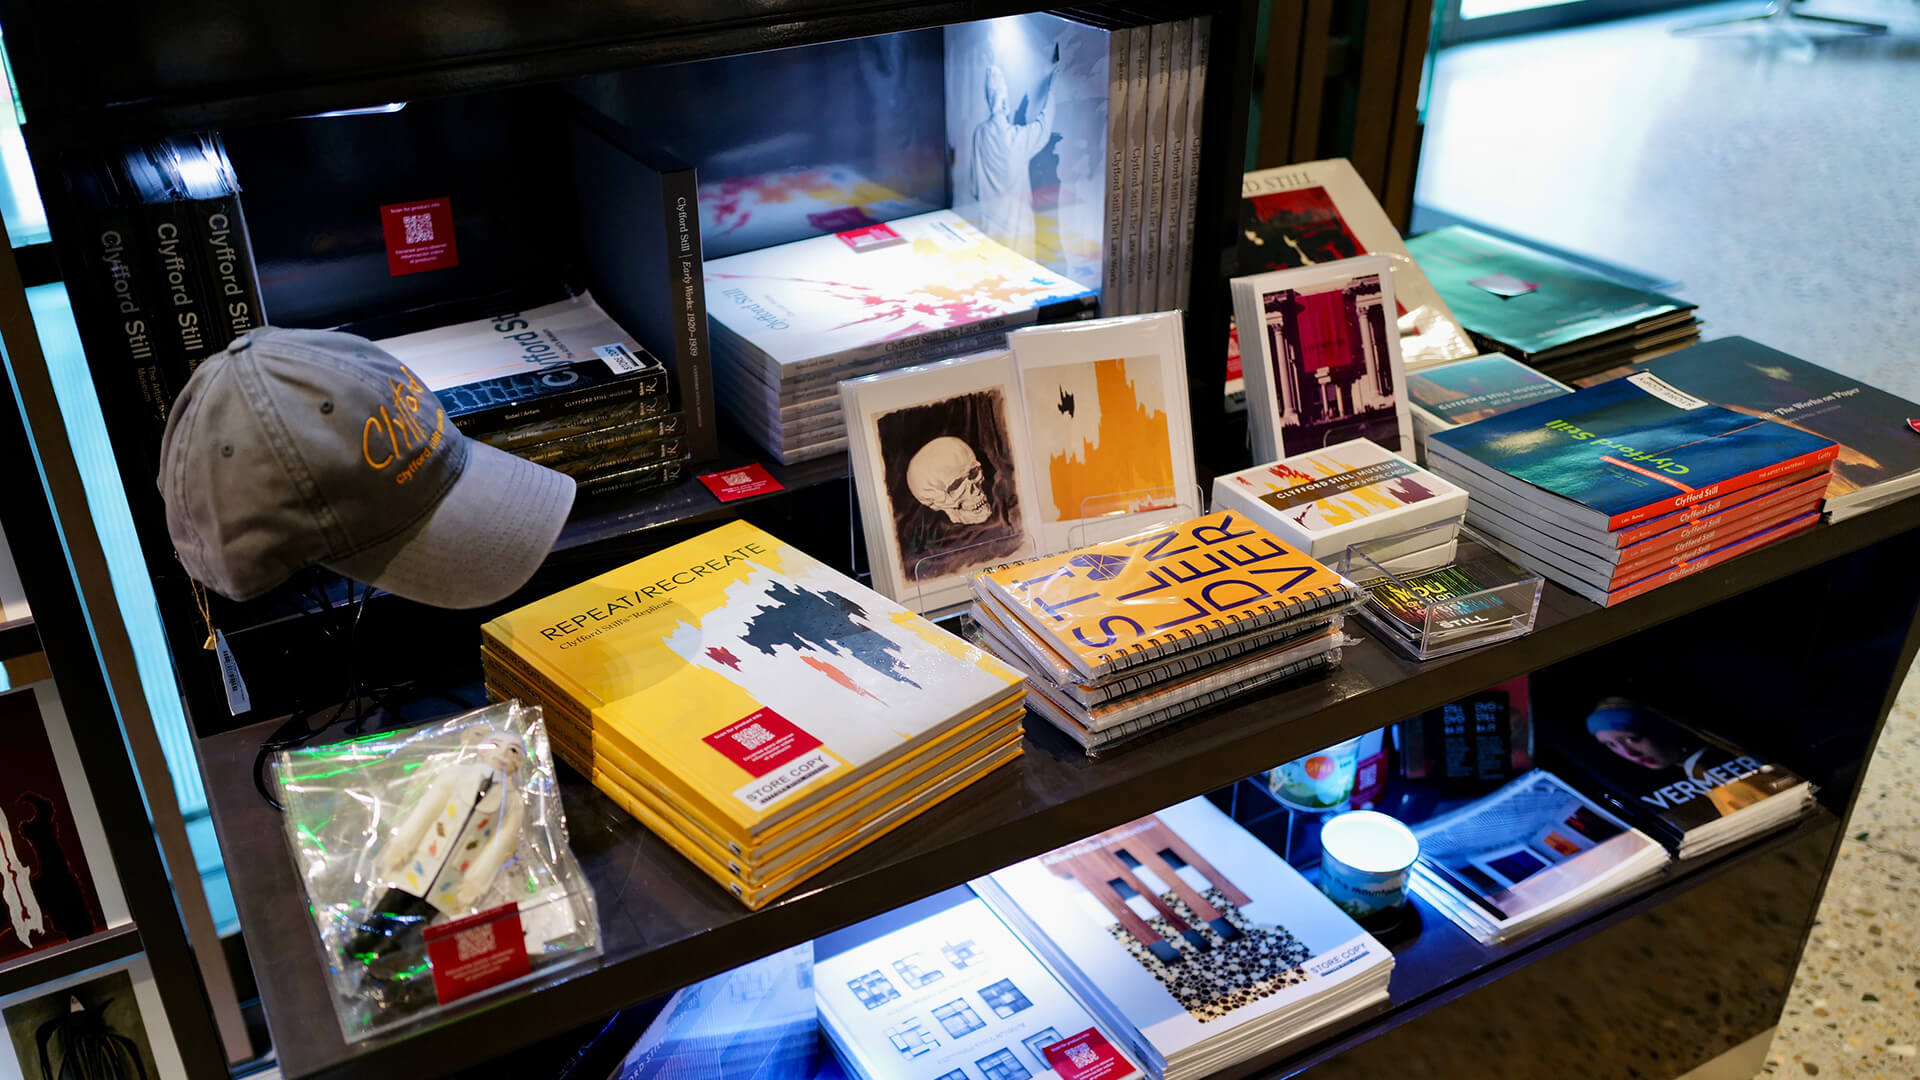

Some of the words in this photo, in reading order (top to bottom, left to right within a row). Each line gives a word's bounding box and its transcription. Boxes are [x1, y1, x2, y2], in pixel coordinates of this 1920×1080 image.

[1112, 151, 1121, 191] Clyfford
[1130, 148, 1140, 187] Clyfford
[676, 196, 688, 232] Clyfford
[1112, 217, 1120, 234] The
[680, 234, 690, 252] Still
[157, 223, 193, 306] Clyfford
[178, 312, 204, 350] Still
[208, 213, 244, 296] Clyfford
[228, 302, 252, 335] Stil
[682, 262, 693, 284] Early
[101, 231, 140, 314] Clyfford
[124, 320, 152, 359] Still
[722, 288, 751, 304] Still
[741, 303, 790, 330] Clyfford
[885, 335, 920, 352] Clyfford
[942, 327, 958, 340] The
[960, 324, 978, 337] Late
[979, 318, 1004, 332] Works
[503, 331, 580, 388] Clyfford
[564, 397, 593, 408] CLYFFORD
[594, 394, 606, 402] STILL
[1438, 394, 1487, 410] CLYFFORD
[1486, 391, 1511, 401] STILL
[1512, 382, 1555, 394] MUSEUM
[1774, 406, 1796, 416] The
[1792, 398, 1823, 410] Works
[1832, 387, 1860, 398] Paper
[1544, 419, 1597, 441] Still
[1590, 437, 1690, 476] Clyfford
[1276, 480, 1329, 500] CLYFFORD
[1328, 474, 1355, 486] STILL
[1357, 462, 1400, 476] MUSEUM
[1675, 490, 1704, 506] Clyfford
[1704, 486, 1719, 498] Still
[1680, 504, 1707, 522] Clyfford
[1708, 501, 1721, 512] Still
[1675, 535, 1702, 552] Clyfford
[1702, 530, 1716, 542] Still
[1680, 521, 1708, 538] Clyfford
[1708, 516, 1722, 528] Still
[1670, 548, 1696, 564] Clyfford
[1697, 544, 1711, 554] Still
[1668, 564, 1696, 580] Clyfford
[1696, 559, 1710, 570] Still
[540, 542, 767, 640] REPEAT/RECREATE
[559, 629, 603, 650] Clyfford
[601, 617, 628, 635] Still's
[1438, 615, 1489, 629] STILL
[745, 774, 790, 802] STORE
[790, 755, 824, 778] COPY
[1640, 755, 1764, 810] VERMEER
[1310, 956, 1342, 974] STORE
[1341, 943, 1366, 959] COPY
